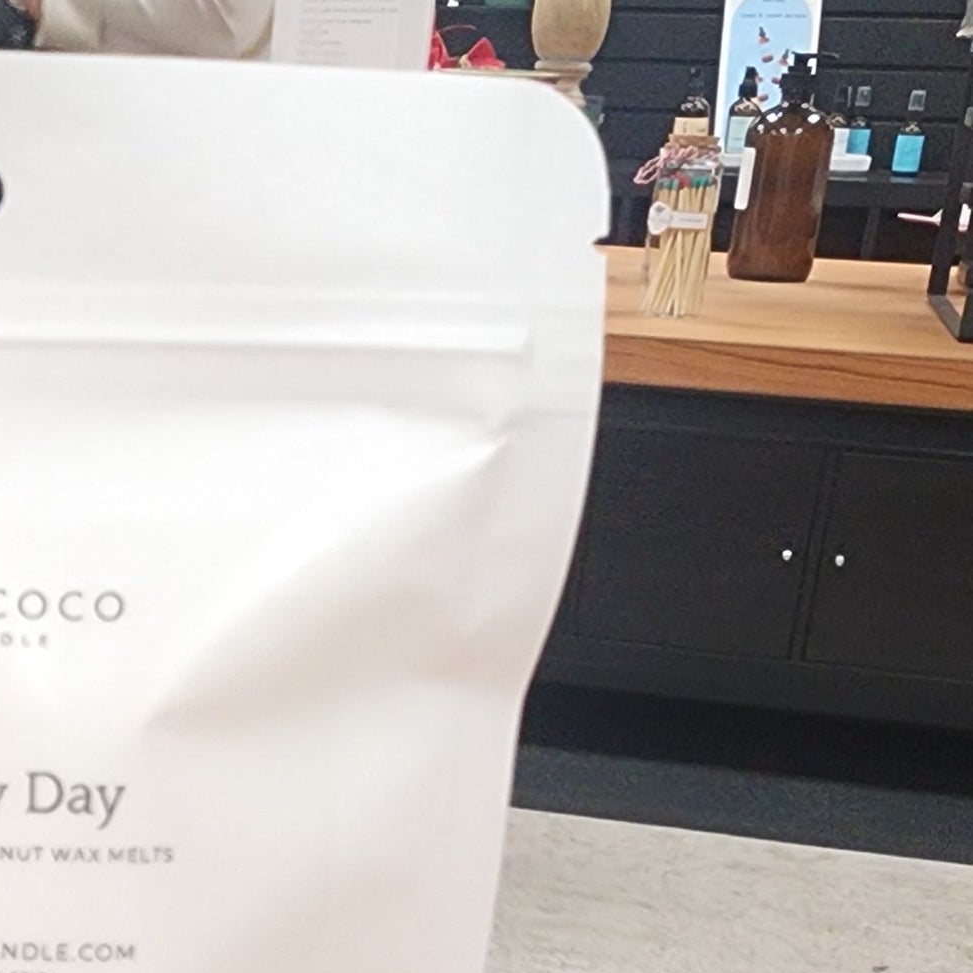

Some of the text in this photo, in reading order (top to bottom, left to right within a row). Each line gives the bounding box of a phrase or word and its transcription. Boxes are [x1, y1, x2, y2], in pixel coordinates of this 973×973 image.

[25, 771, 127, 831] Day
[50, 845, 102, 863] WAX
[107, 847, 174, 864] MELTS
